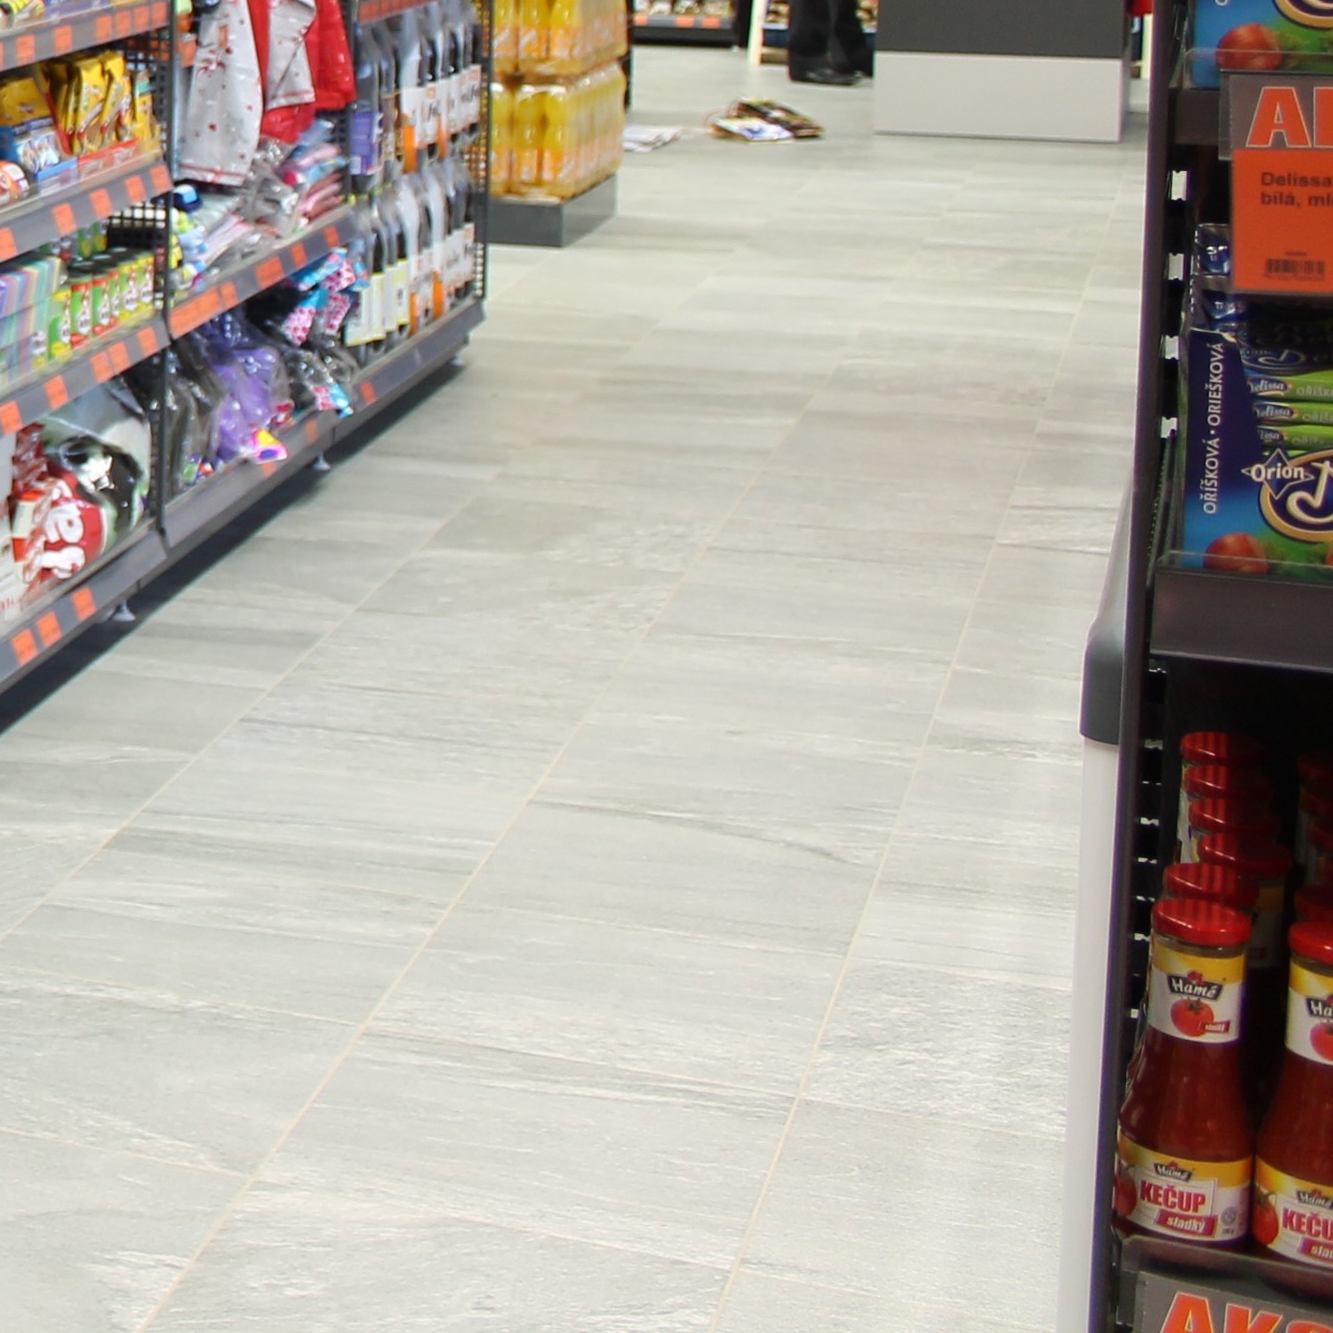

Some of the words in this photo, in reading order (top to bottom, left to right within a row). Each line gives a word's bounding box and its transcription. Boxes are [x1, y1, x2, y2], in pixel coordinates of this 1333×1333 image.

[1203, 343, 1225, 427] ORIEŠKOVÁ
[1199, 437, 1221, 515] OŘÍŠKOVÁ
[1251, 463, 1304, 484] Orion
[1170, 977, 1222, 1001] Hamé
[1141, 1180, 1206, 1213] KEČUP
[1167, 1217, 1206, 1233] sladký
